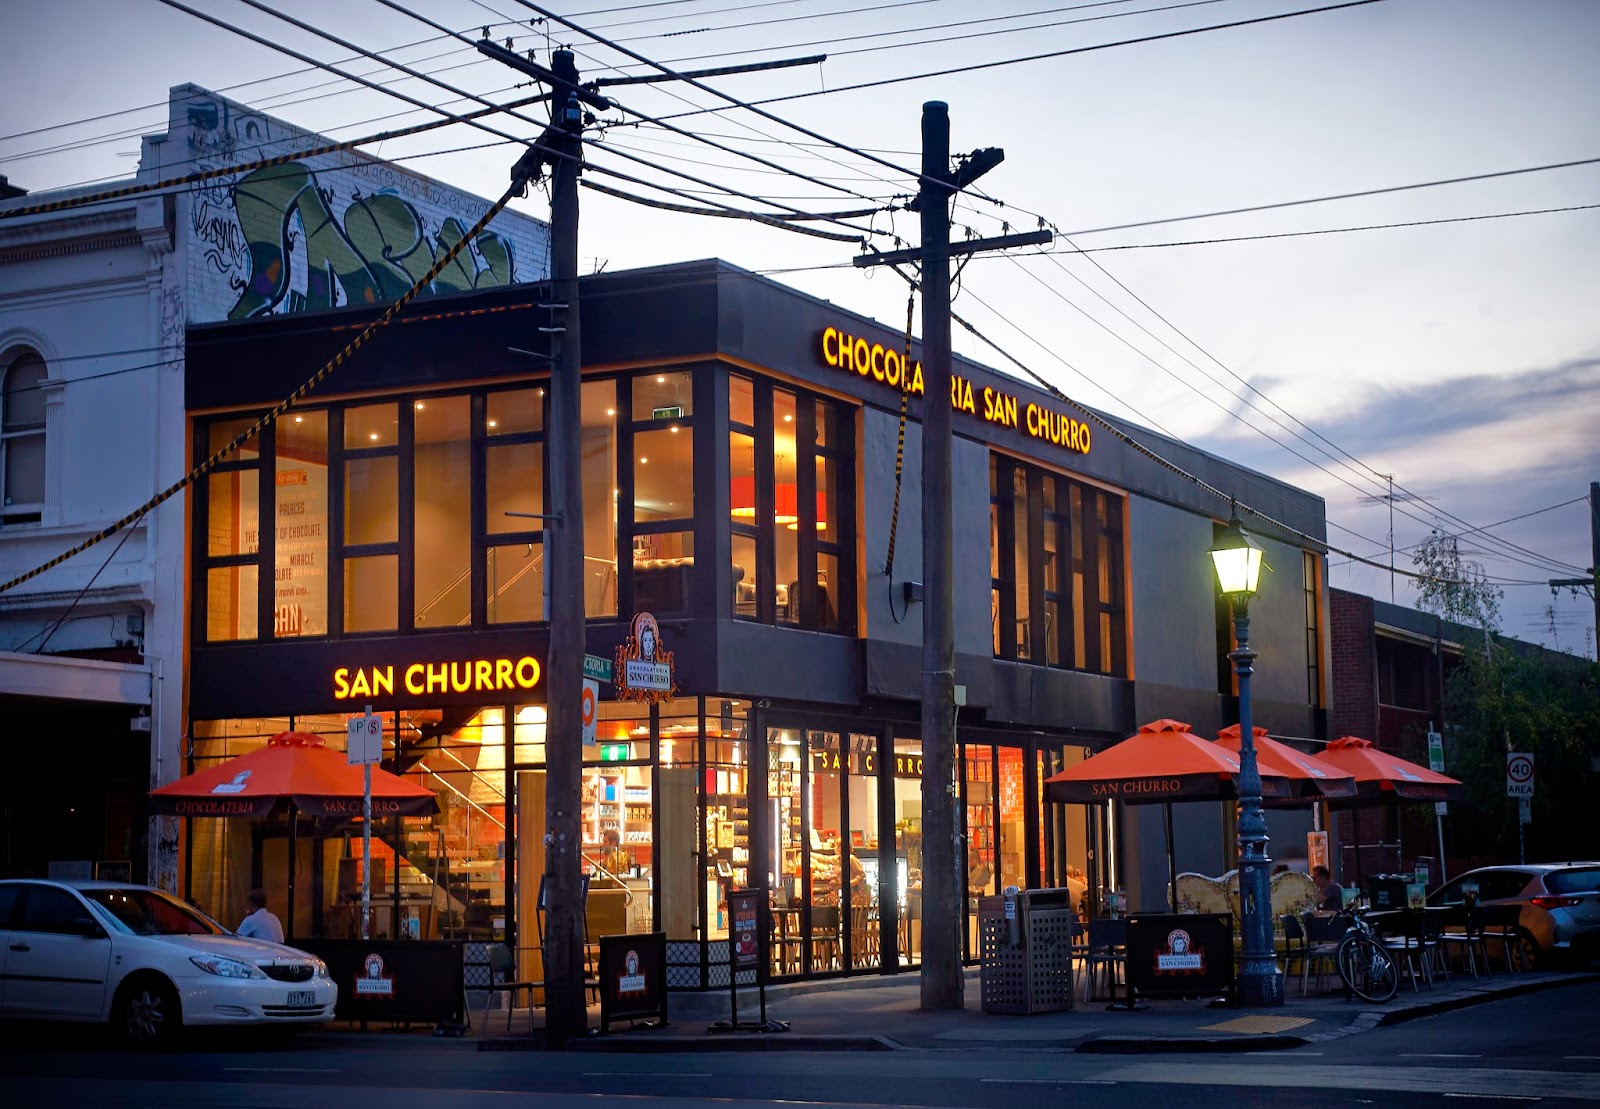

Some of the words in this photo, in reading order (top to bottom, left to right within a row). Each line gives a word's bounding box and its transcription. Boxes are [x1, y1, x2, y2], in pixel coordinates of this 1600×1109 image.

[373, 164, 395, 187] are
[822, 326, 975, 414] CHOCOLARIA
[984, 386, 1018, 428] SAN
[1026, 402, 1091, 454] CHURRO
[279, 501, 305, 516] PALACES
[245, 531, 256, 543] THE
[280, 527, 288, 540] OF
[290, 552, 314, 567] MIRACLE
[629, 665, 668, 673] CHOCOLATERIA
[333, 666, 394, 700] SAN
[404, 655, 541, 695] CHURRO
[629, 673, 643, 682] SAN
[643, 673, 669, 684] CHURRO
[1512, 764, 1530, 776] 40
[1092, 782, 1119, 796] SAN
[1123, 779, 1181, 794] CHURRO
[1508, 785, 1533, 795] AREA
[175, 800, 254, 814] CHOCOLATERIA
[323, 800, 346, 813] SAN
